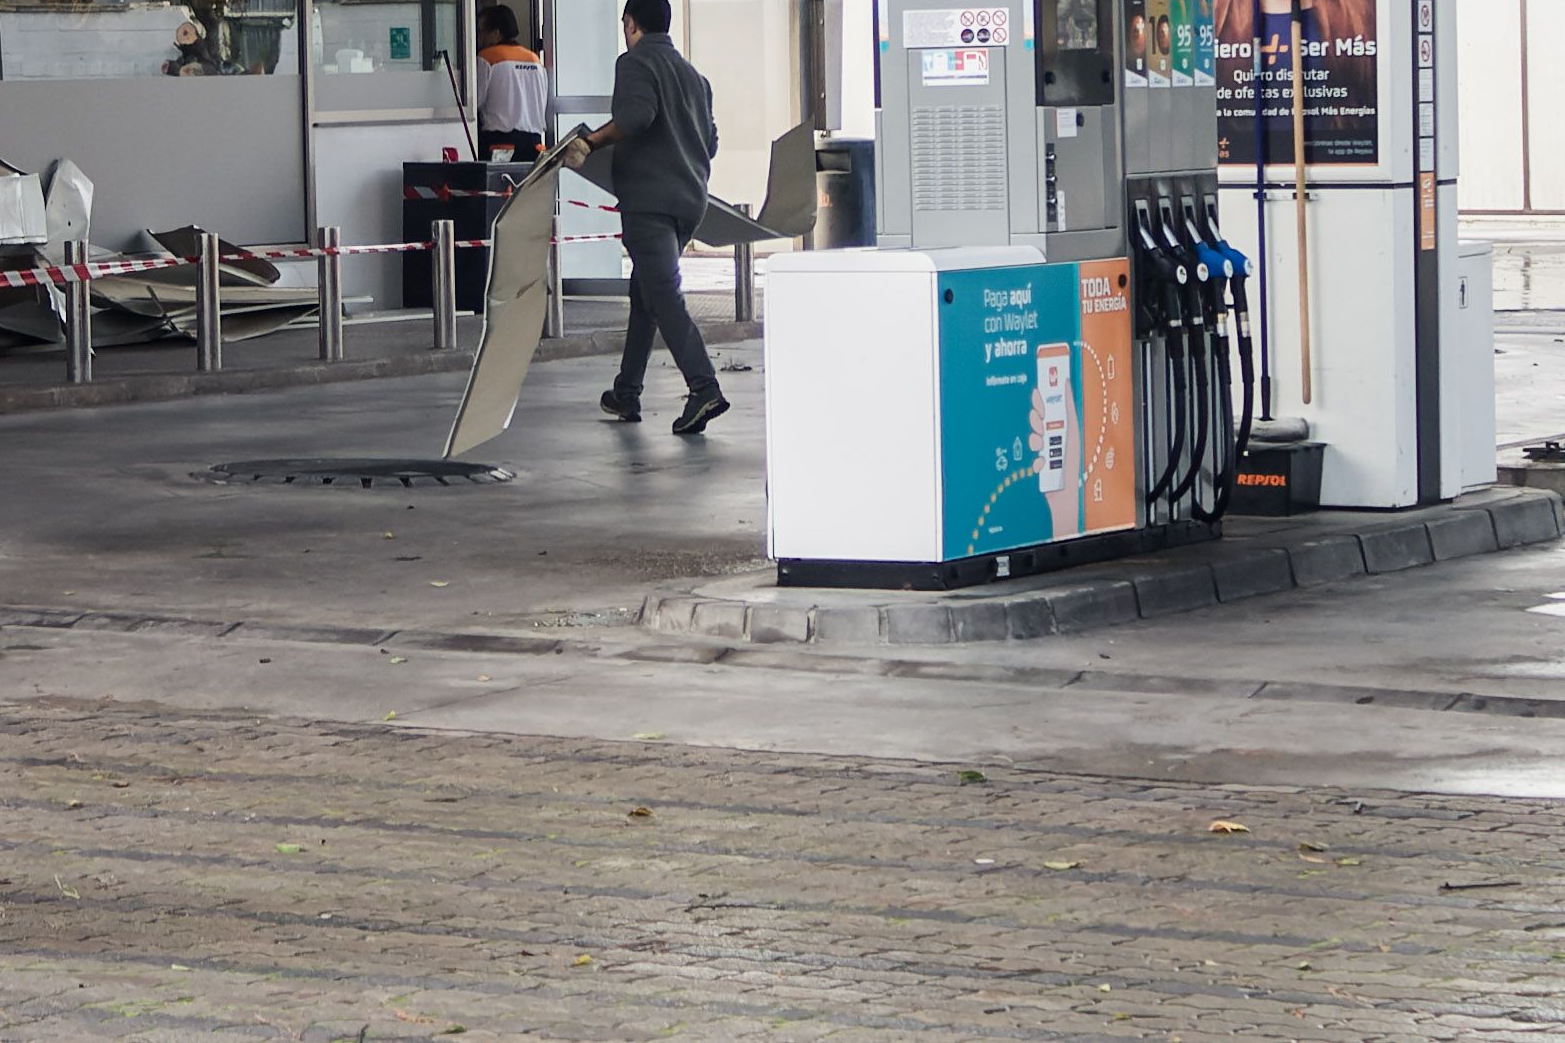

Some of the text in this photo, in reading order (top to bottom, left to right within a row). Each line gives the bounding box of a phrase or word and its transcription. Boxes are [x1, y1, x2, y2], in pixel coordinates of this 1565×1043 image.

[1177, 24, 1192, 47] 95
[1199, 24, 1213, 47] 95
[1336, 34, 1377, 57] Más
[1233, 68, 1273, 84] Quiro
[1216, 86, 1233, 100] de
[984, 282, 1032, 311] Paga aquí
[1081, 277, 1111, 298] TODA
[1082, 292, 1127, 314] TU ENERGÍA
[984, 310, 1038, 335] con Waylet
[985, 336, 1028, 363] y ahorra
[1237, 473, 1286, 487] REPSOL
